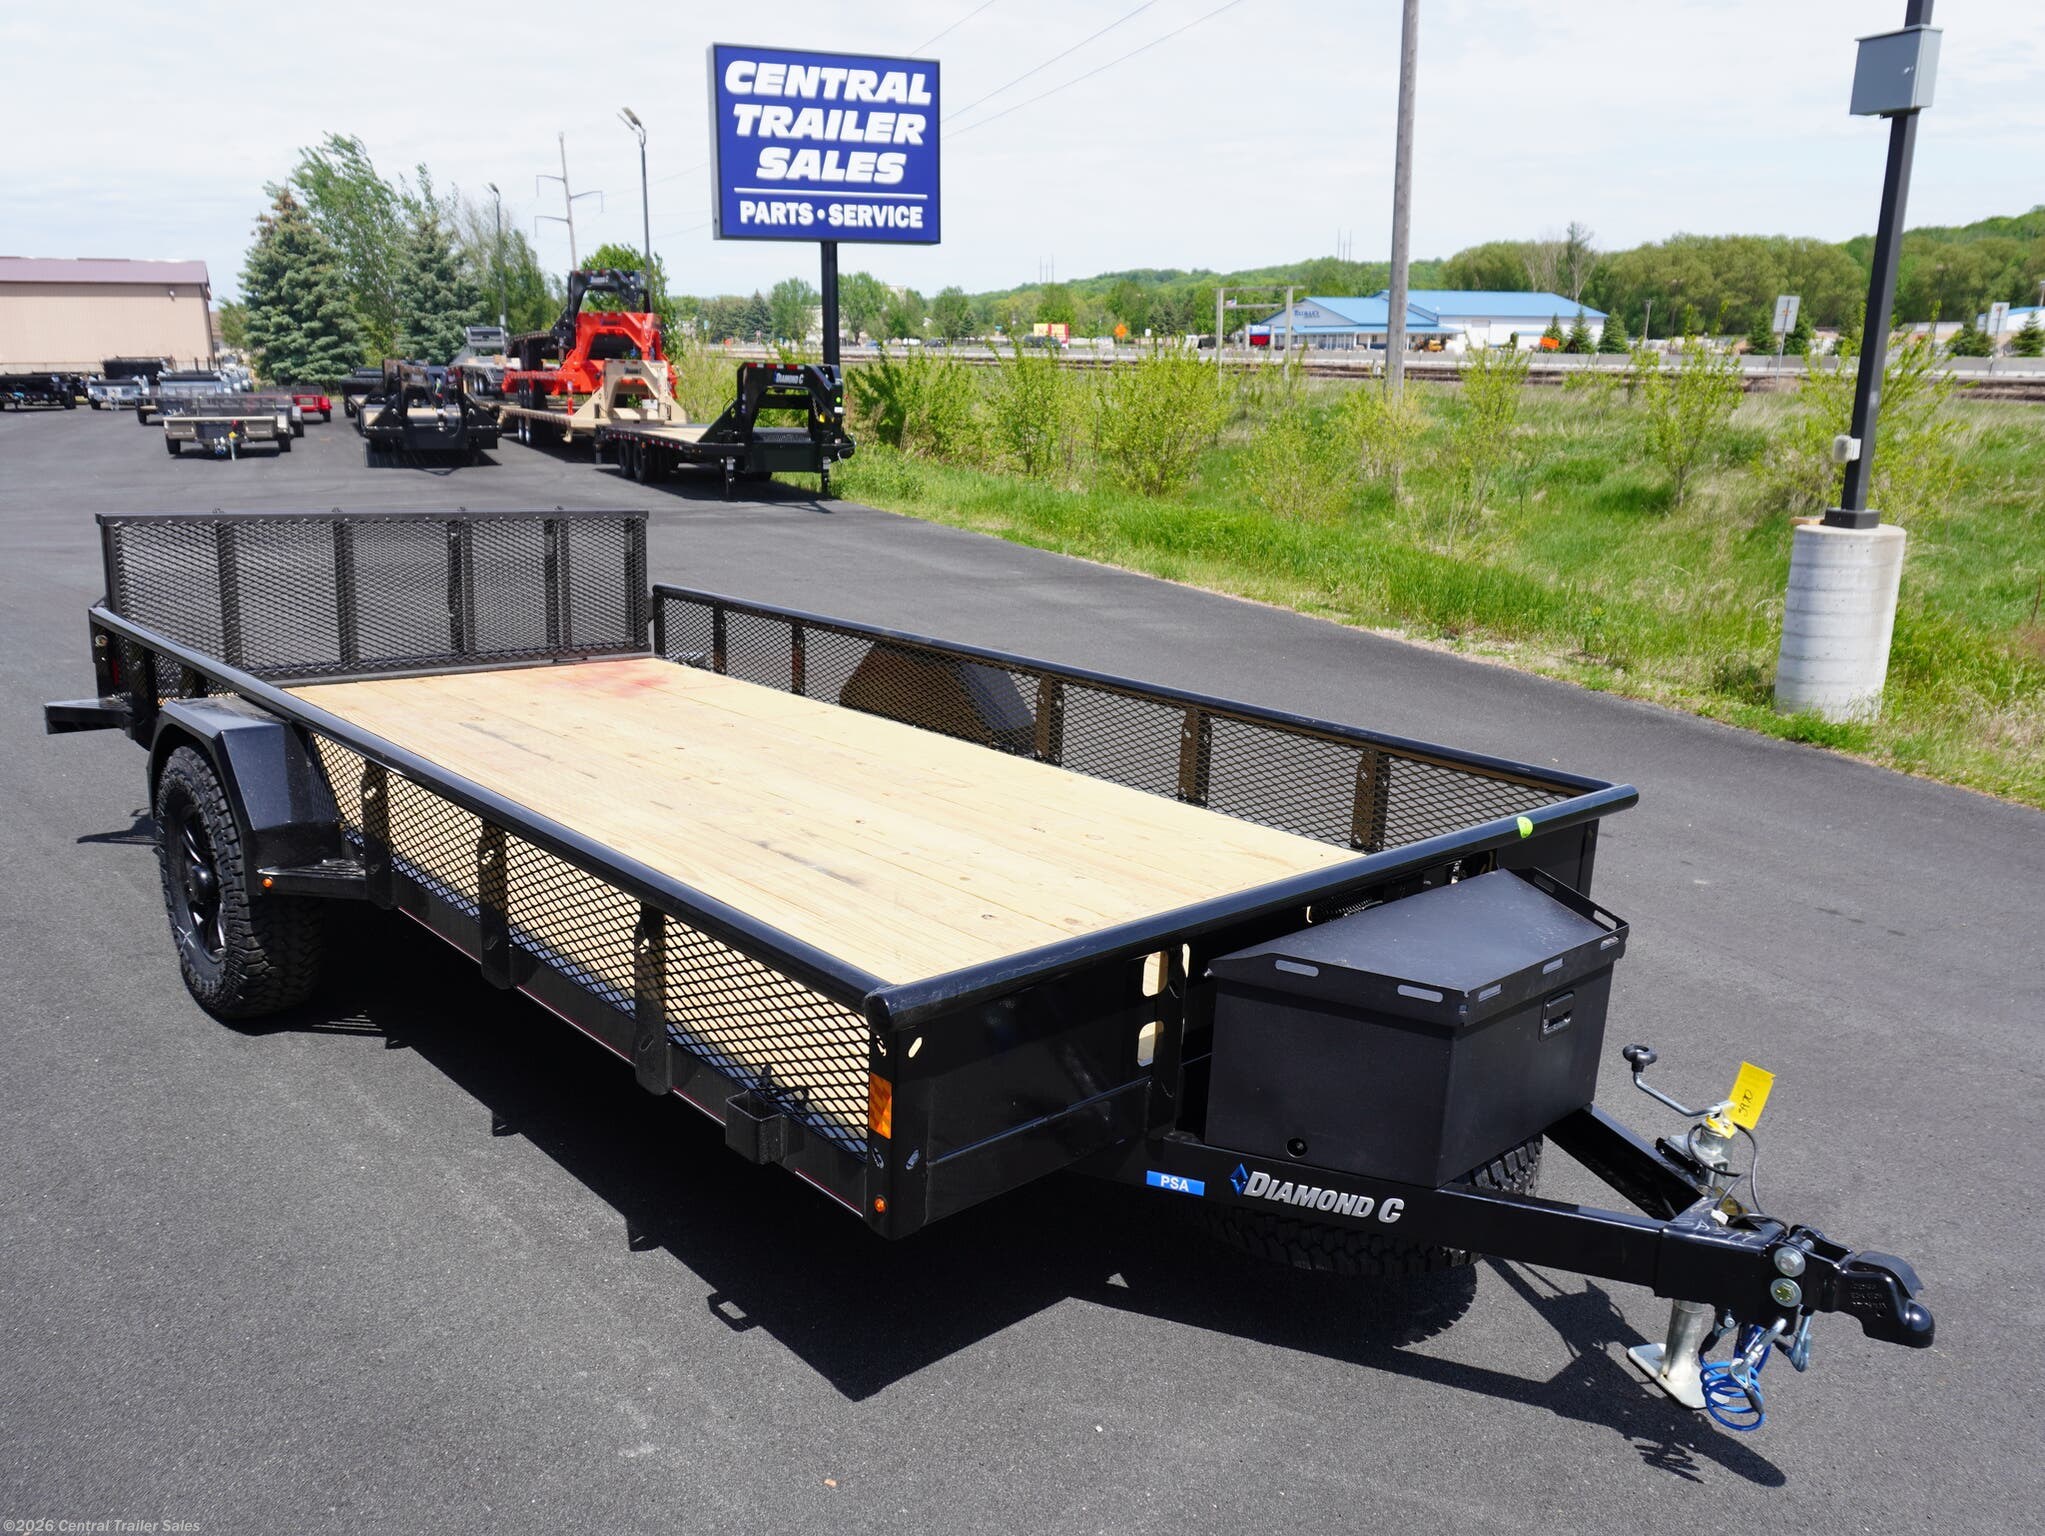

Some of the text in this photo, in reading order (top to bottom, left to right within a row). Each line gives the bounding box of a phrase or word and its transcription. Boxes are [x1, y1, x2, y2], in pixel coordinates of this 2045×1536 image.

[725, 60, 932, 106] CENTRAL
[733, 103, 926, 145] TRAILER
[756, 147, 907, 185] SALES
[740, 200, 923, 228] PARTS SERVICE
[1160, 1175, 1189, 1193] PSA
[1243, 1171, 1405, 1224] DIAMOND C
